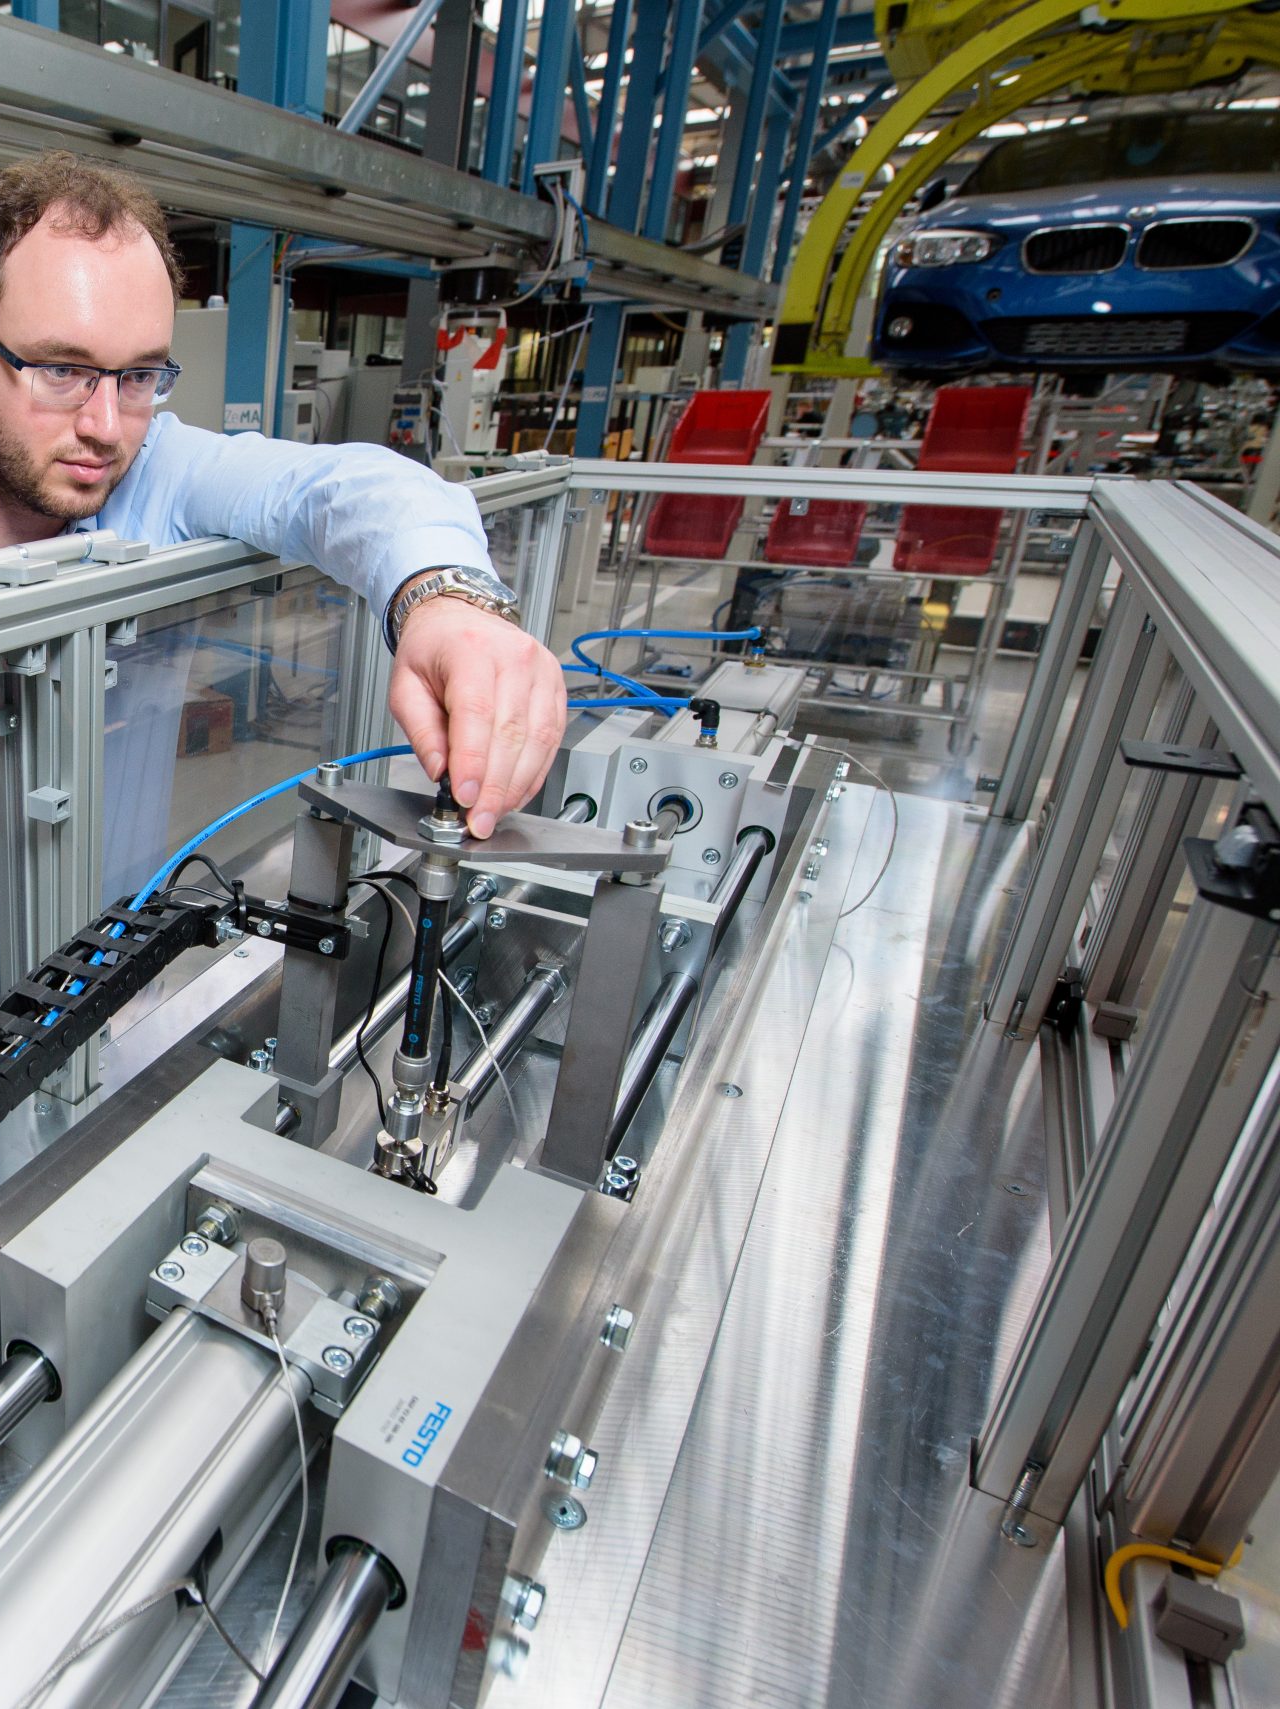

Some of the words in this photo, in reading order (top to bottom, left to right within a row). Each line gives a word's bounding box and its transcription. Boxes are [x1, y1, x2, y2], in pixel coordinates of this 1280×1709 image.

[224, 409, 260, 423] ZeMA
[414, 974, 424, 1005] FESTO
[402, 1402, 452, 1466] FESTO
